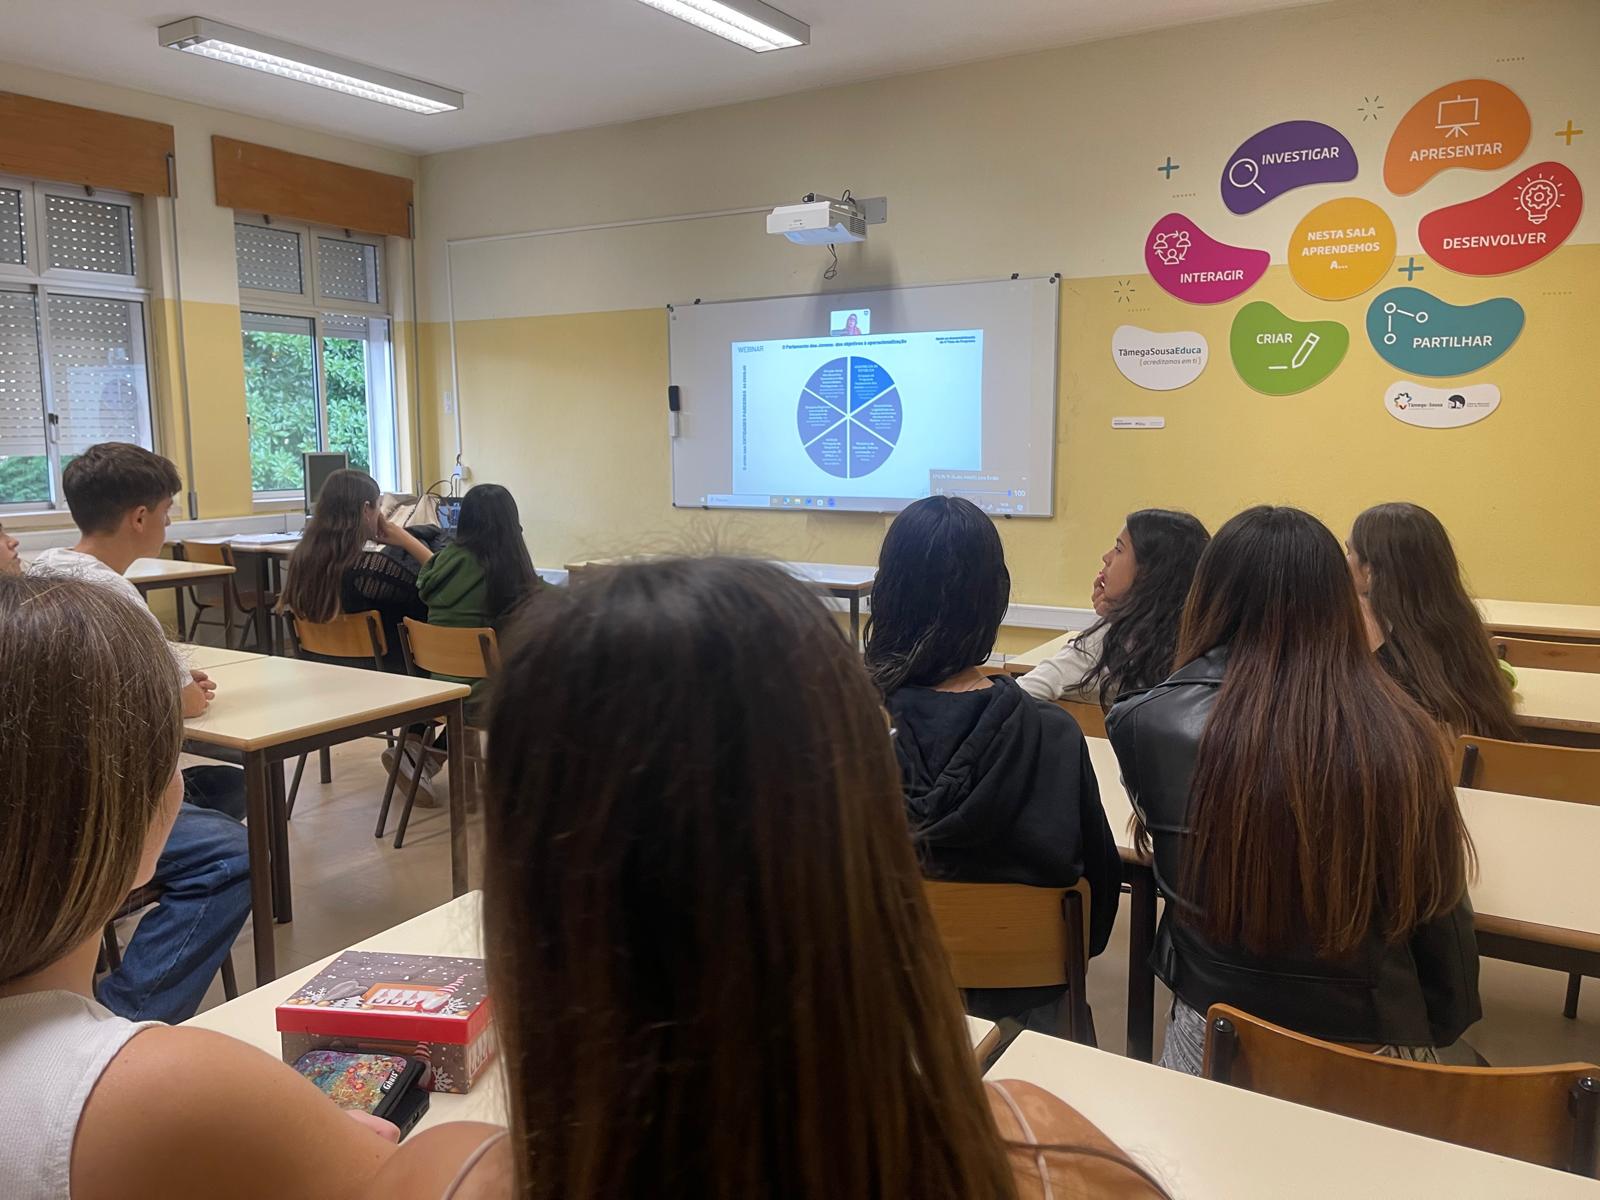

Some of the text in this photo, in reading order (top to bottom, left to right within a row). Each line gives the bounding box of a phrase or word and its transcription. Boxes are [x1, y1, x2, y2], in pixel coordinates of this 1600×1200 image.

[1261, 145, 1341, 165] INVESTIGAR
[1409, 142, 1503, 162] APRESENTAR
[1307, 227, 1376, 241] NESTA SALA
[1442, 231, 1547, 250] DESENVOLVER
[1301, 241, 1380, 257] APRENDEMOS
[1329, 260, 1348, 270] A...
[1179, 269, 1244, 284] INTERAGIR
[1255, 332, 1293, 345] CRIAR
[1412, 335, 1493, 349] PARTILHAR
[737, 345, 764, 353] WEBINAR
[1118, 347, 1201, 357] TâmegaSousaEduca
